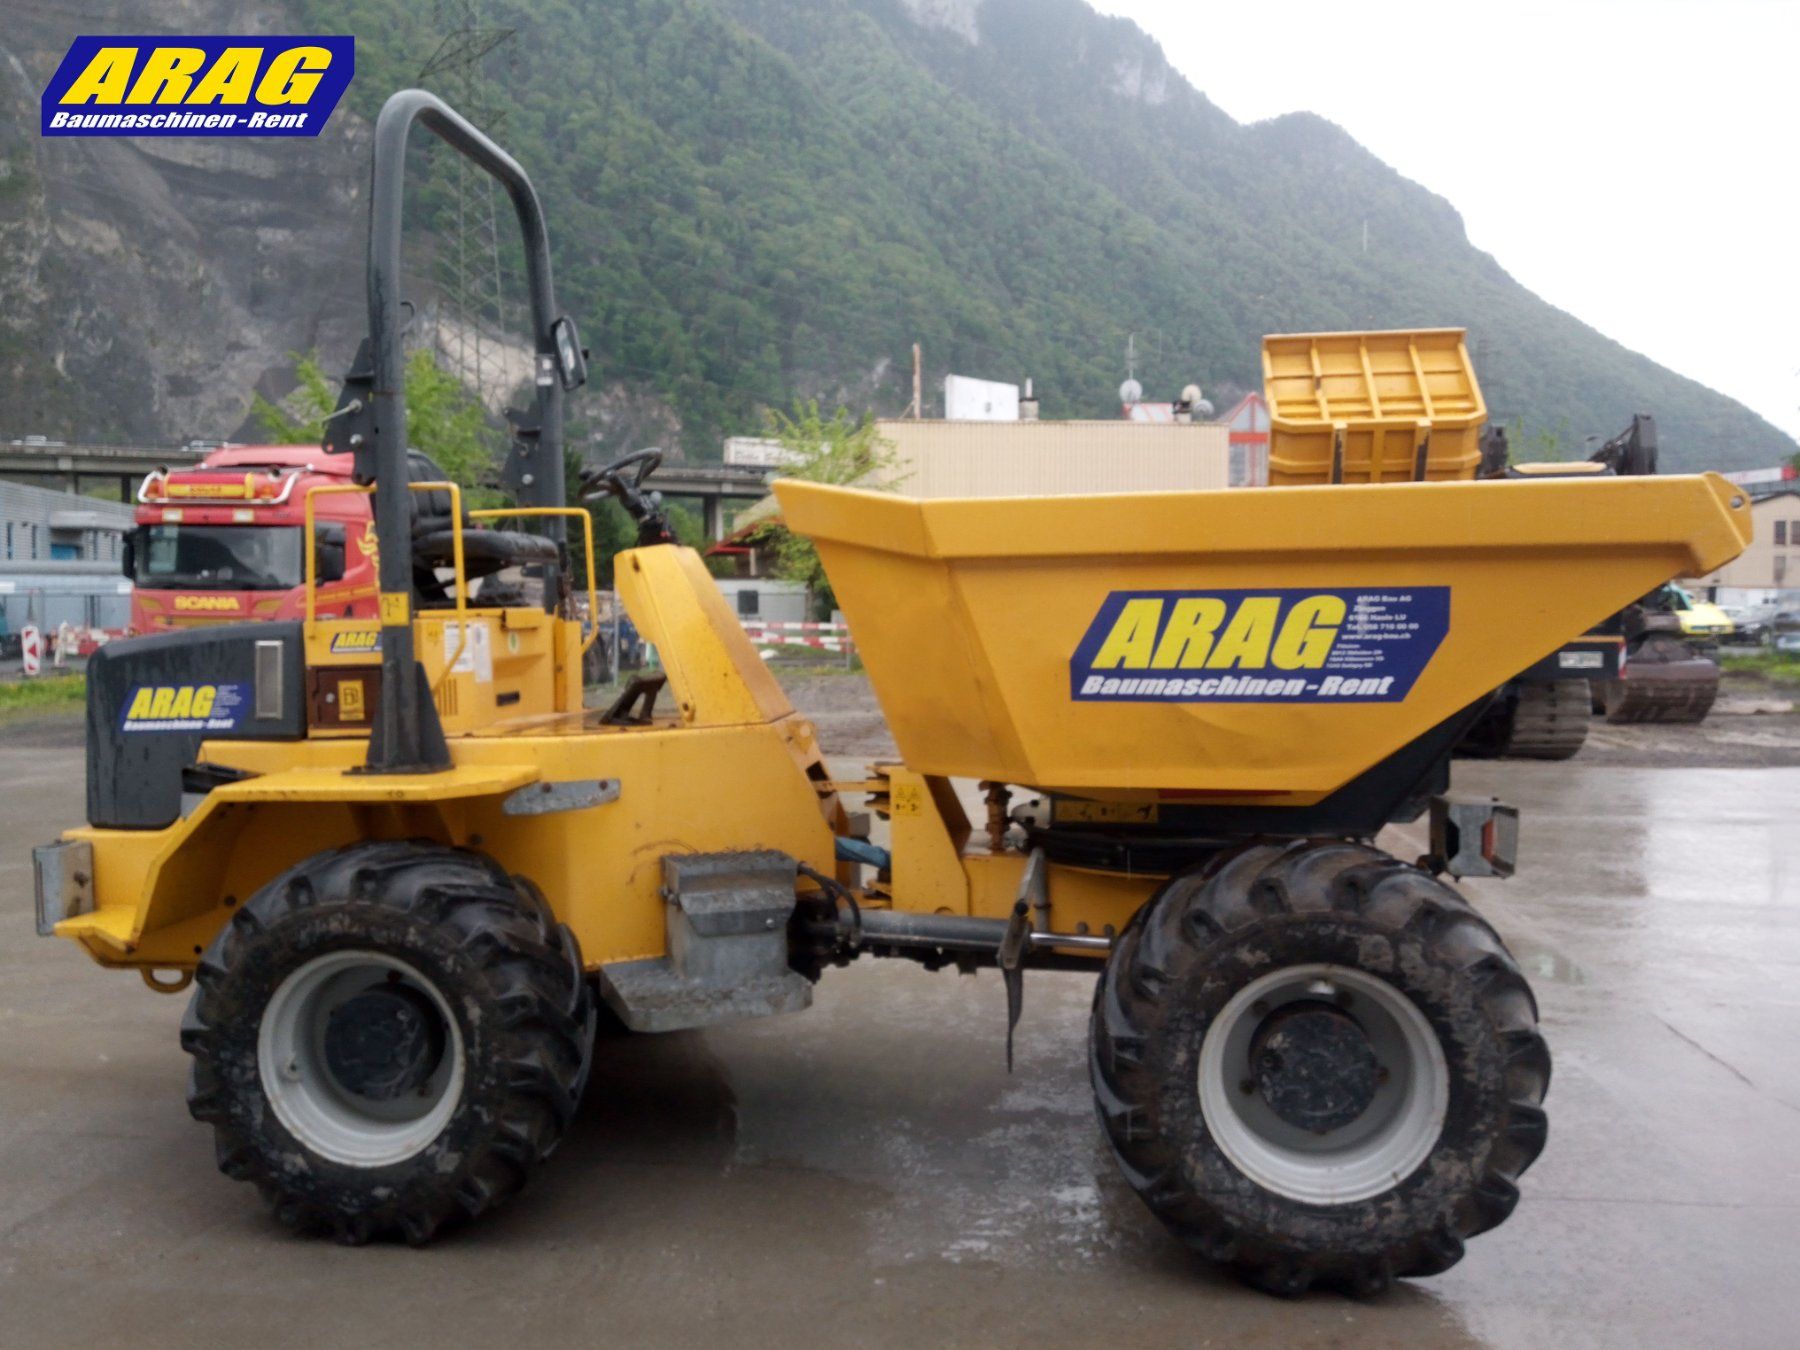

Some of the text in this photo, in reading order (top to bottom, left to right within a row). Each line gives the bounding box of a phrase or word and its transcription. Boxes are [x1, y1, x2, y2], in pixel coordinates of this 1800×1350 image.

[174, 596, 241, 611] SCANIA
[334, 632, 379, 648] ARAG
[1090, 594, 1347, 670] ARAG
[1079, 675, 1395, 697] Baumaschinen-Rent
[126, 685, 217, 720] ARAG
